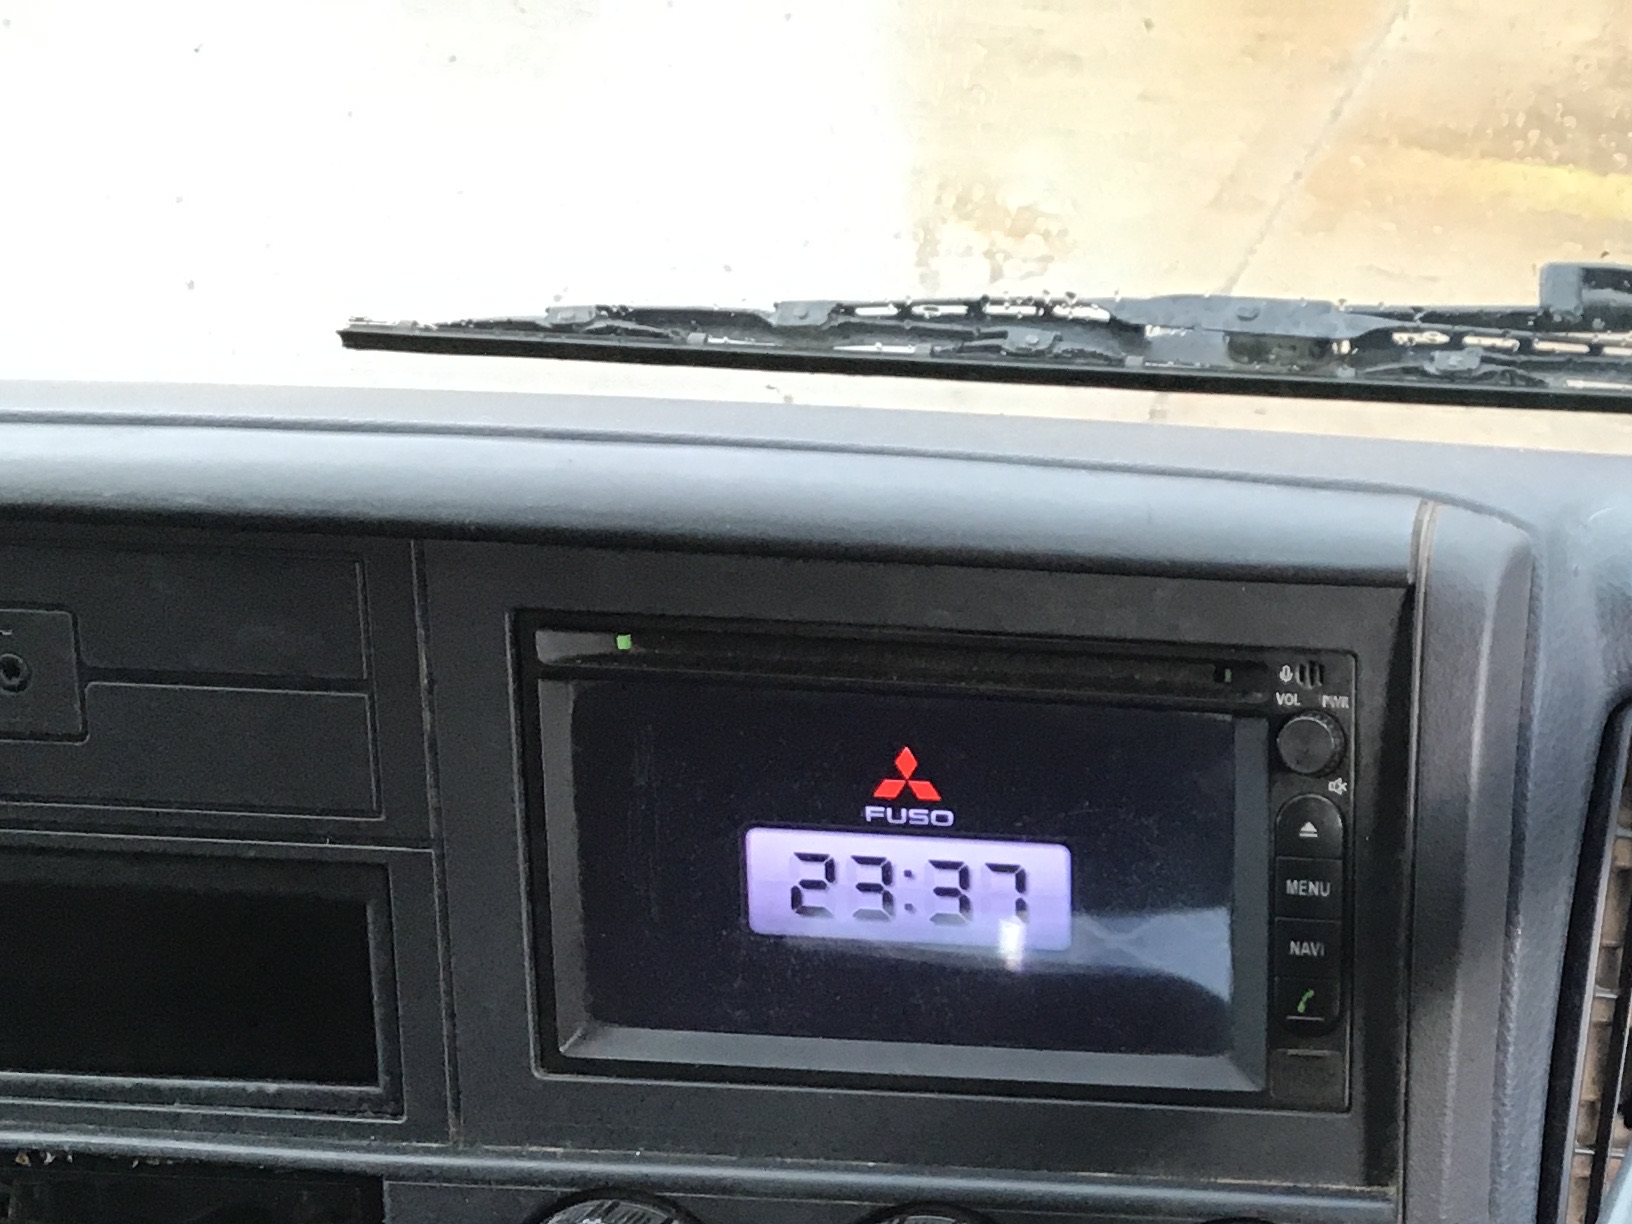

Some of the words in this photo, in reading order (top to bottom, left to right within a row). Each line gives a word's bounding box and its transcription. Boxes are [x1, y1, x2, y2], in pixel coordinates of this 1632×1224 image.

[1275, 691, 1301, 707] VOL
[864, 805, 955, 828] FUSO
[790, 851, 1031, 927] 23:37
[1285, 878, 1332, 897] MENU
[1289, 940, 1325, 957] NAVI
